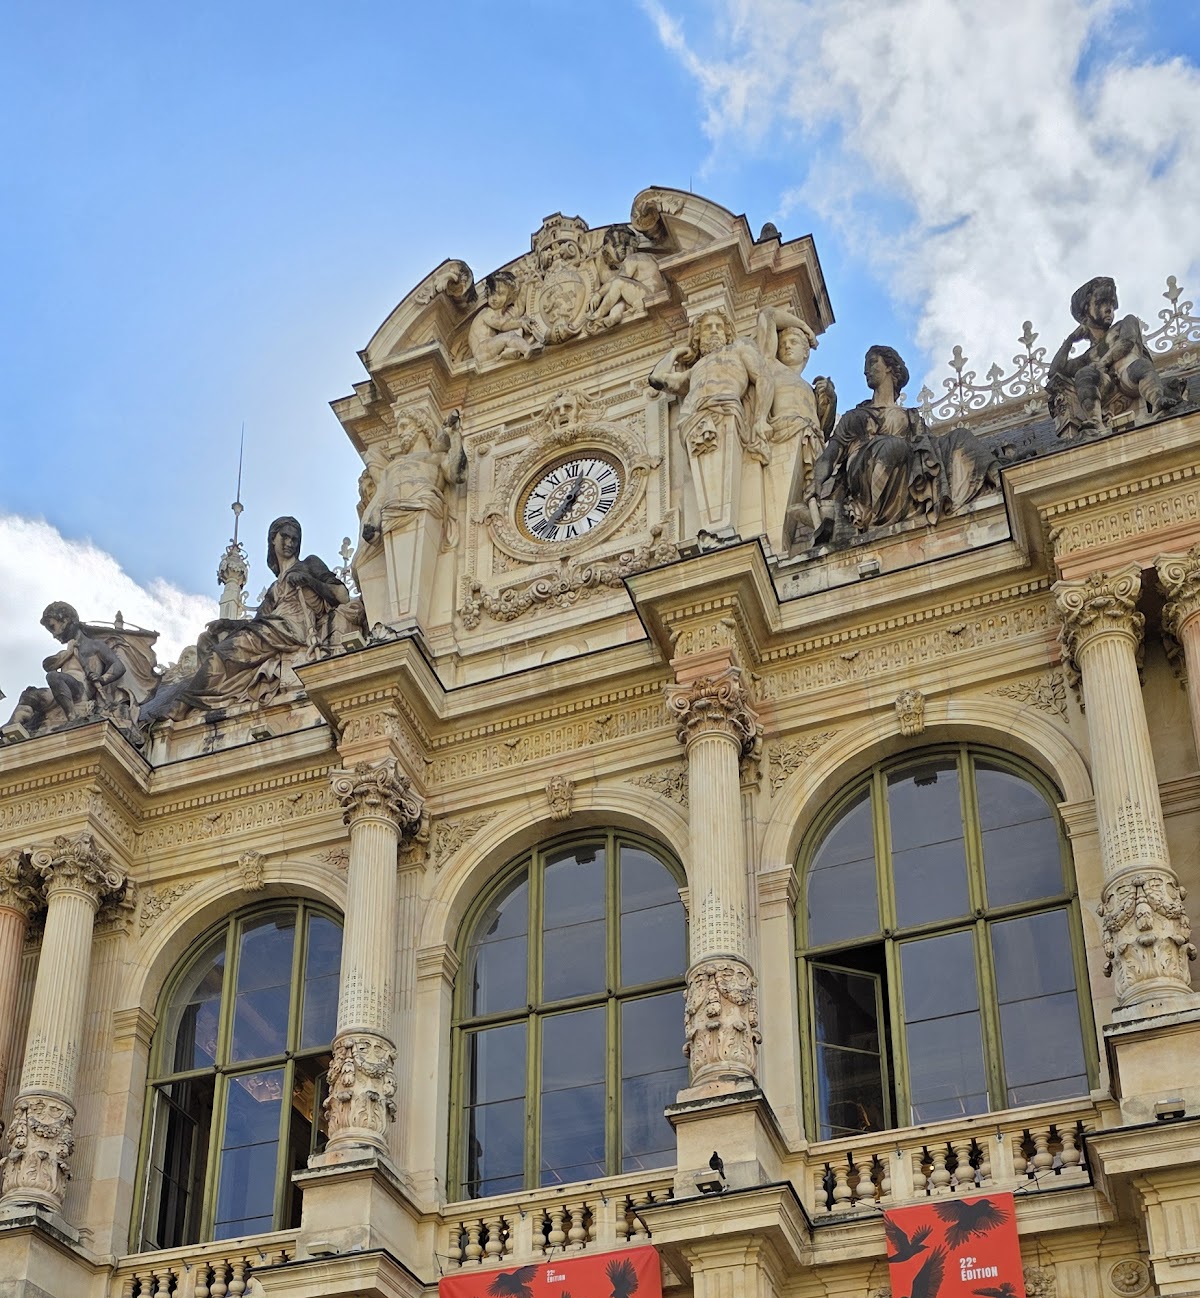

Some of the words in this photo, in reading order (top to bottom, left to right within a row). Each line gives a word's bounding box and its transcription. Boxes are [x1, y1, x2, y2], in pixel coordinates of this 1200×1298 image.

[565, 464, 580, 480] XII
[585, 463, 595, 476] I
[596, 469, 612, 482] II
[546, 474, 561, 490] XI
[601, 483, 616, 495] III
[532, 492, 548, 500] X
[528, 506, 543, 520] IX
[586, 517, 599, 529] V
[566, 525, 579, 538] VI
[961, 1266, 998, 1281] ÉDITION
